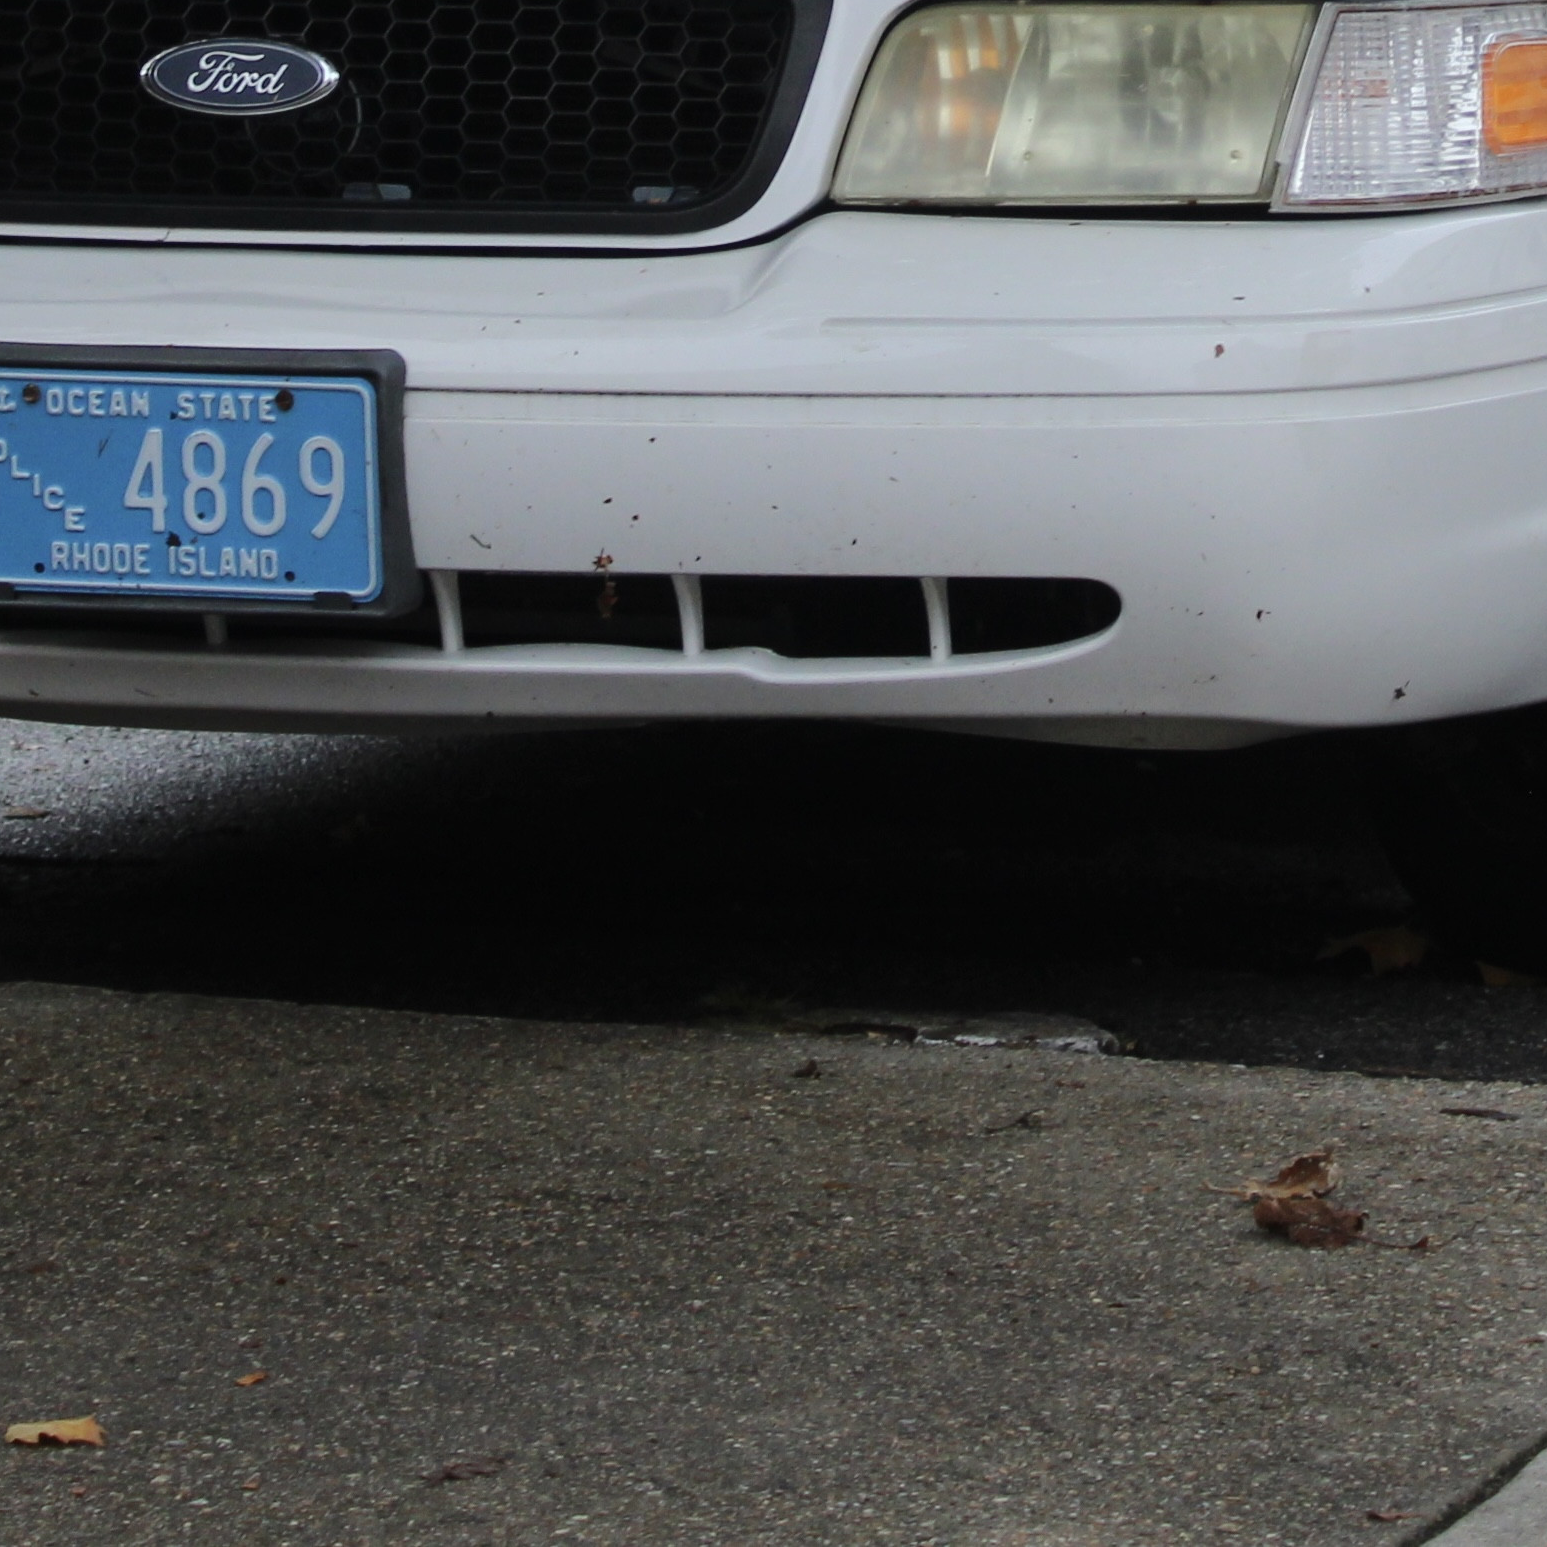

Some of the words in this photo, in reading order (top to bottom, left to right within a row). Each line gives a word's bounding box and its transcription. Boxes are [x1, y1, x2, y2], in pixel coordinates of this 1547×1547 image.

[187, 51, 288, 94] Ford
[46, 388, 150, 418] OCEAN
[176, 392, 277, 423] STATE
[123, 428, 345, 540] 4869
[51, 542, 151, 576] RHODE
[168, 545, 279, 581] ISLAND
